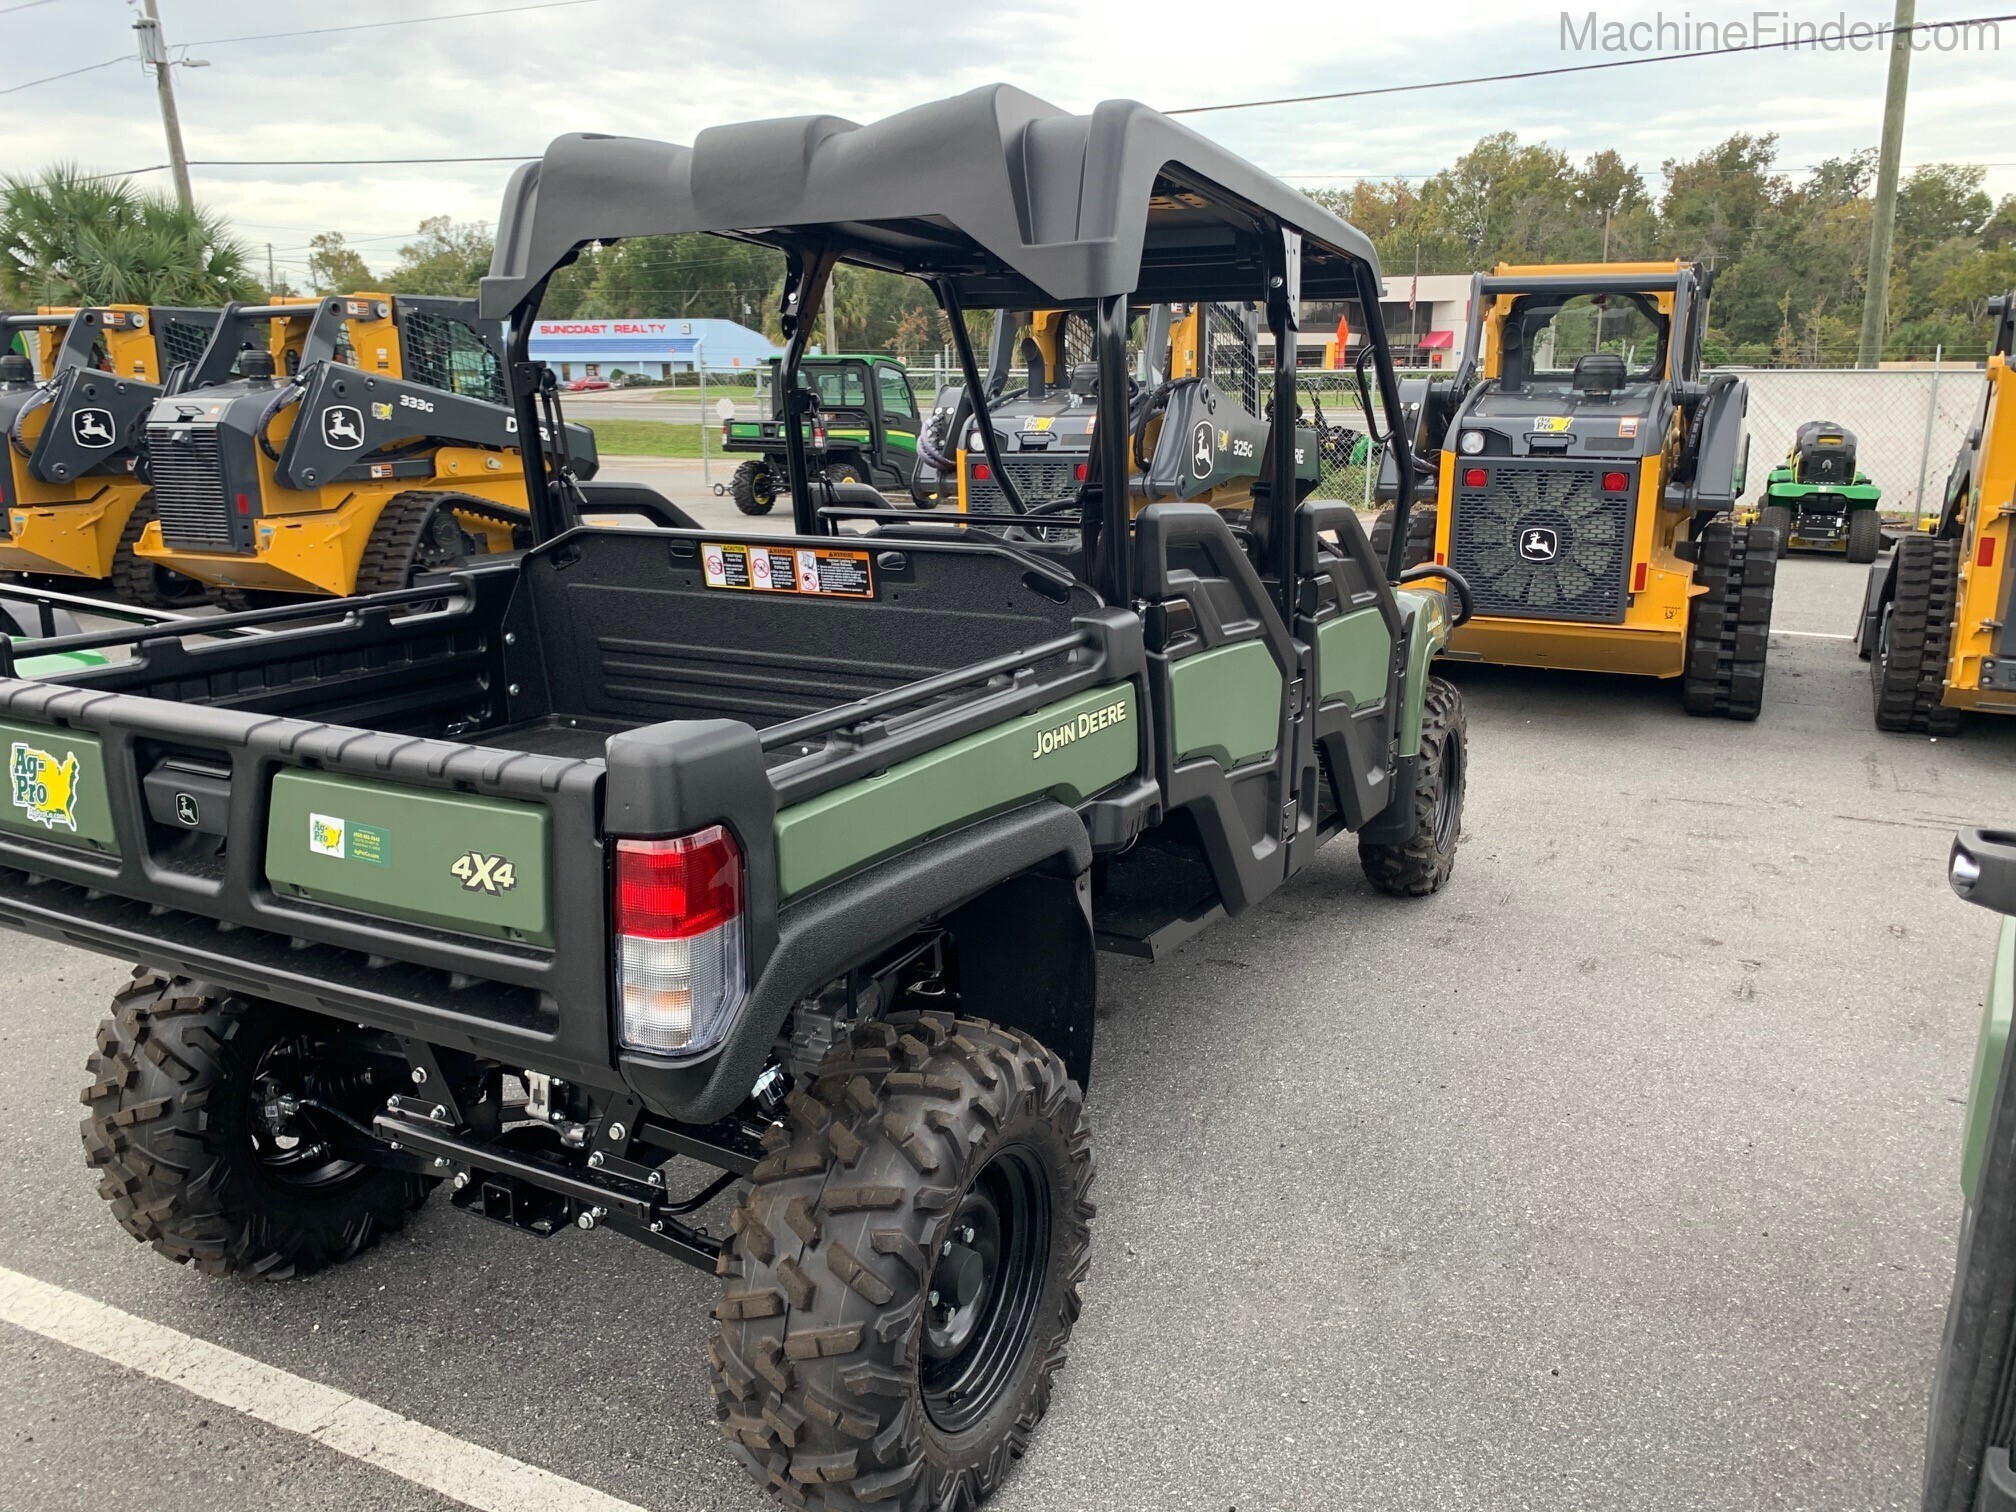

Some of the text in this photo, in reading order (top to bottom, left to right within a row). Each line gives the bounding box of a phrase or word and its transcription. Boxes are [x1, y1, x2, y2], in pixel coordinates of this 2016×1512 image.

[540, 324, 666, 334] SUNCOAST REALTY
[400, 394, 434, 413] 333G
[1536, 422, 1554, 430] Pro
[1233, 439, 1253, 458] 325G
[1032, 700, 1127, 760] JOHN DEERE
[14, 747, 46, 782] Ag-
[16, 775, 48, 804] Pro
[313, 831, 328, 843] Pro
[451, 851, 516, 894] 4X4
